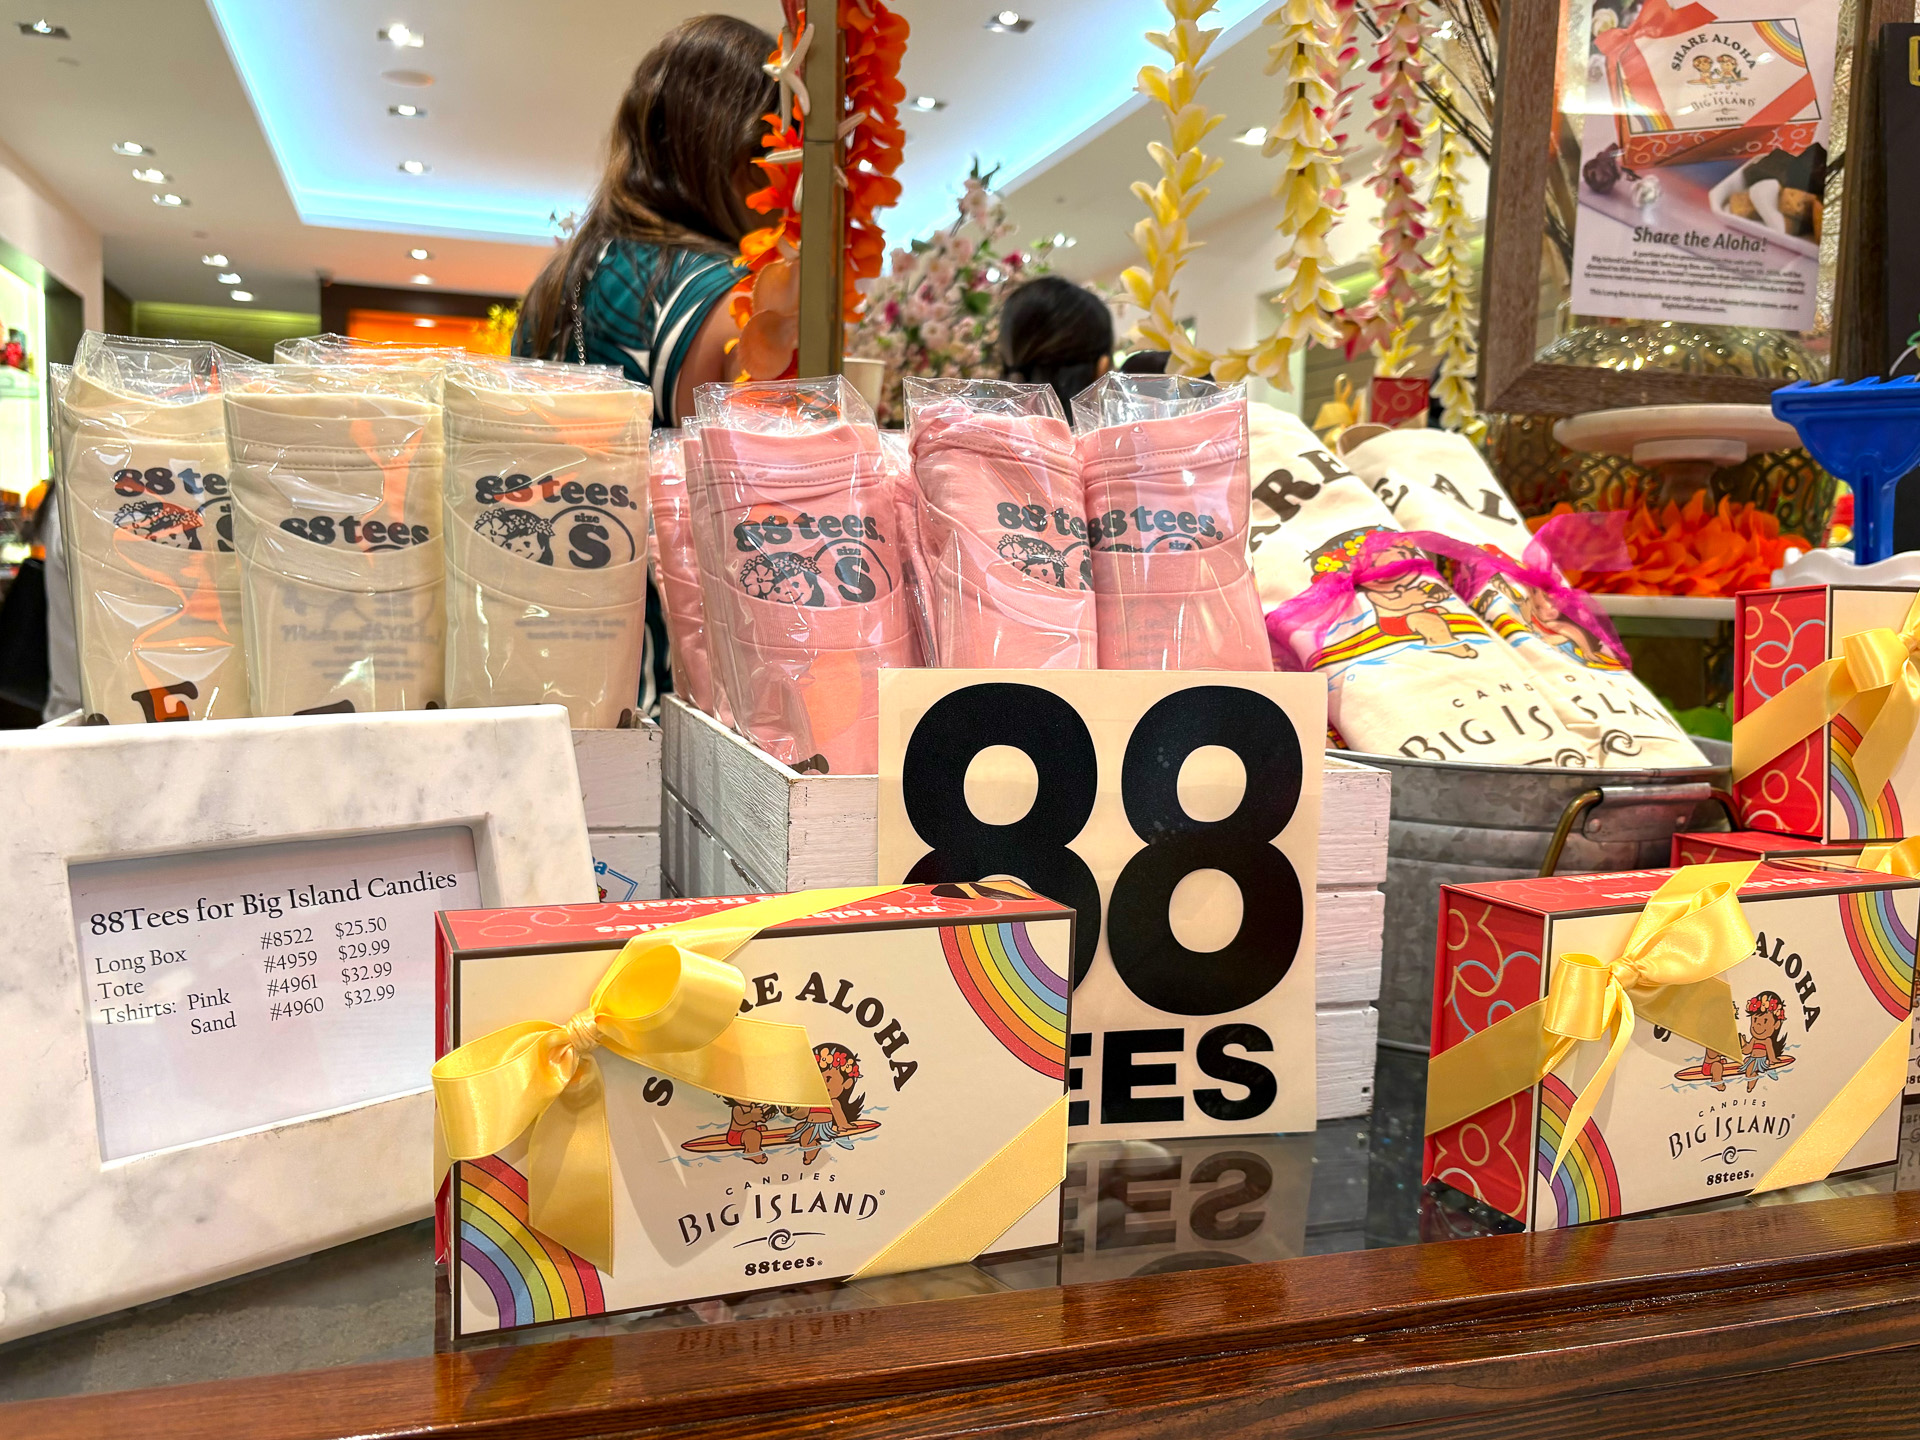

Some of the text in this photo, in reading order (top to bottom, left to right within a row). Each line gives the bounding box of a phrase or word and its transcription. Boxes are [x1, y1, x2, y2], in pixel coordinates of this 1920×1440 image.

[1671, 33, 1757, 72] SHARE ALOHA
[1633, 226, 1768, 253] Share the Aloha!
[567, 523, 612, 569] S
[835, 556, 876, 603] S
[1398, 718, 1497, 761] BIG
[902, 682, 1304, 1017] 88
[90, 870, 458, 936] 88Tees for Big Island Candies
[95, 916, 387, 974] Long Box #8522 $25.50
[97, 938, 391, 999] Tote #4959 $29.99
[100, 961, 392, 1025] Tshirts: Pink #4961 $32.99
[1752, 931, 1821, 1032] ALOHA
[190, 984, 395, 1035] Sand #4960 $32.99
[795, 971, 918, 1092] ALOHA
[1069, 1023, 1278, 1127] ES
[1698, 1098, 1767, 1118] CANDIES
[1668, 1124, 1707, 1160] BIG
[725, 1172, 836, 1196] CANDIES
[678, 1203, 740, 1247] BIG
